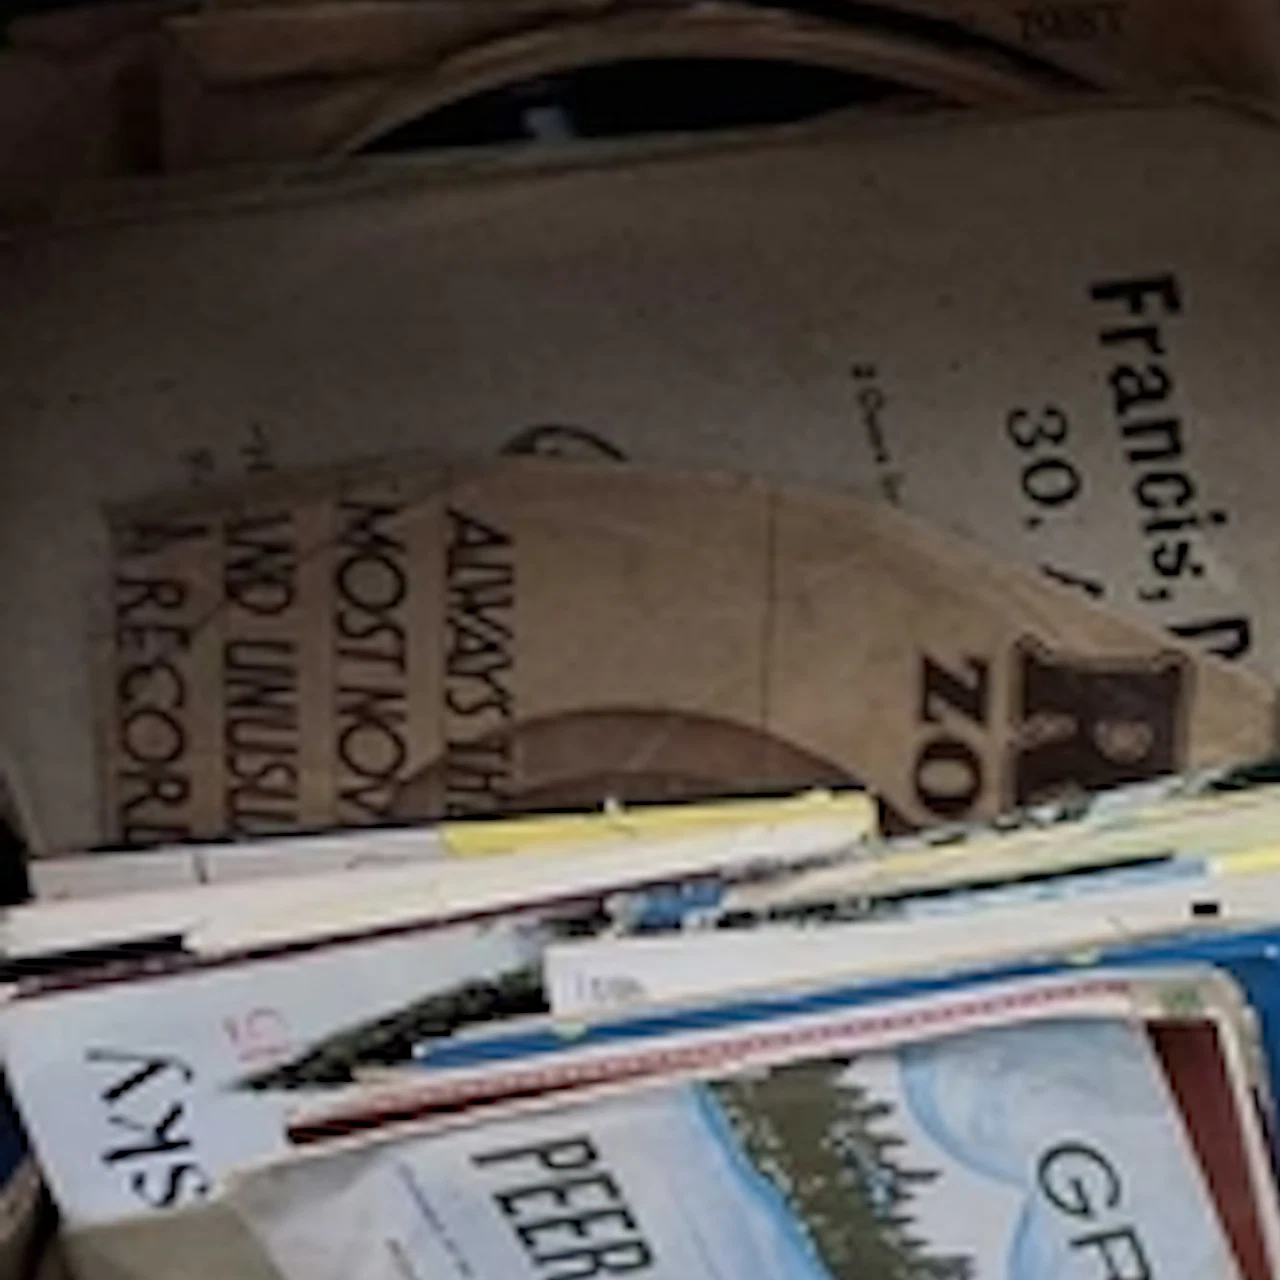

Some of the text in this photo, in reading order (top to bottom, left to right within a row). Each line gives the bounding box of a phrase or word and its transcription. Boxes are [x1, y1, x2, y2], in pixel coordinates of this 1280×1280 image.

[1090, 273, 1228, 602] Francis,
[336, 498, 408, 673] MOST
[446, 506, 516, 820] ALWAYS TH
[226, 640, 298, 836] UNUSU
